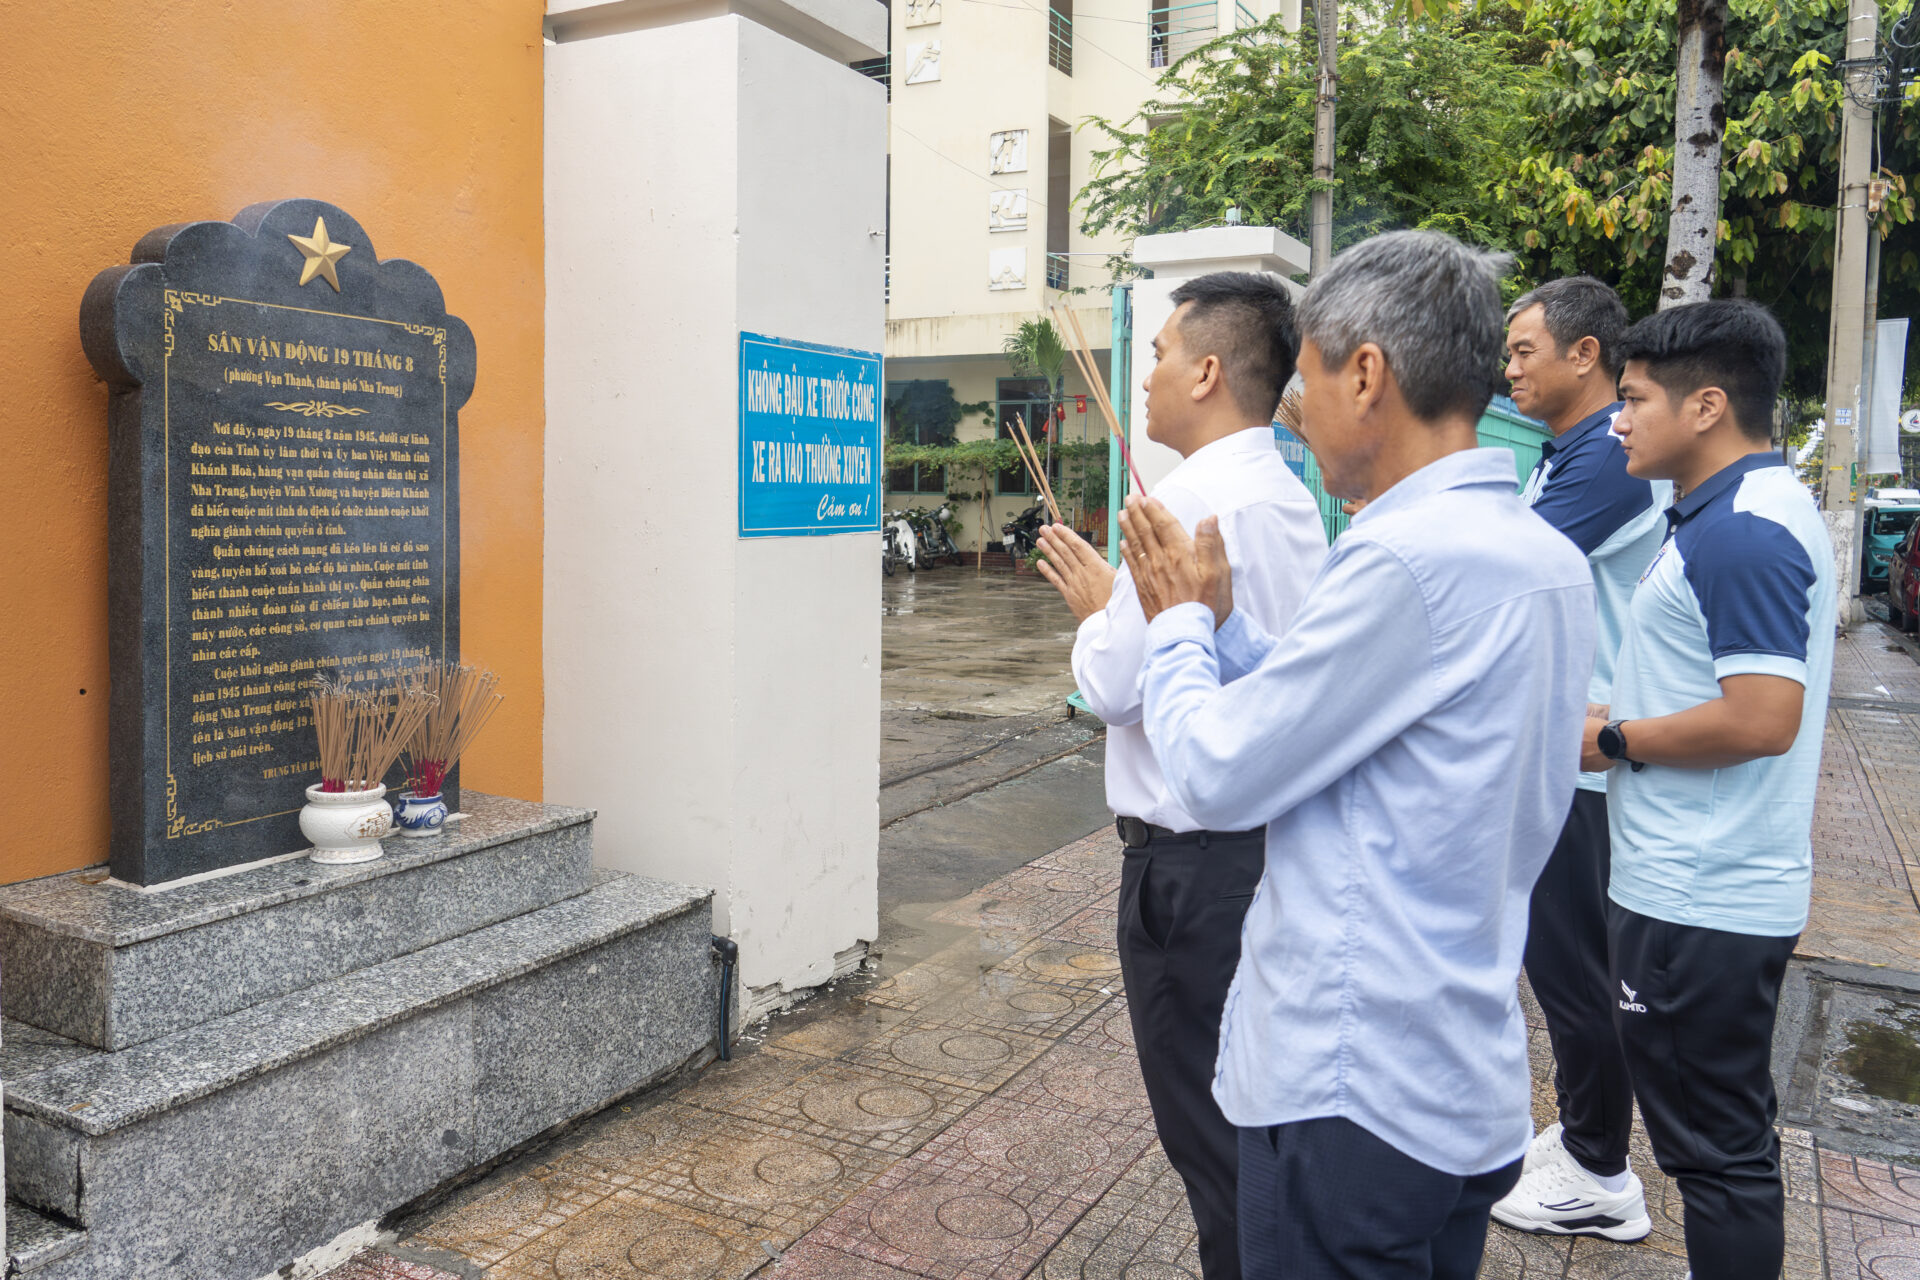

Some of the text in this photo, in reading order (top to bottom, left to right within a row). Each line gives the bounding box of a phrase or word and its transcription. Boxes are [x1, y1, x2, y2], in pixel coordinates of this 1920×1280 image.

[207, 330, 413, 372] SÂN VẬN ĐỘNG 19 THÁNG 8
[264, 370, 282, 388] Vạn
[283, 372, 315, 391] Thạnh,
[316, 375, 341, 390] thành
[342, 377, 358, 393] phố
[358, 379, 374, 393] Nha
[375, 381, 403, 398] Trang)
[748, 359, 874, 424] KHÔNG ĐẬU XE TRƯỚC CỔNG
[752, 431, 871, 485] XE RA VÀO THƯỜNG XUYÊN
[816, 494, 845, 521] Cảm
[848, 502, 863, 517] ơn
